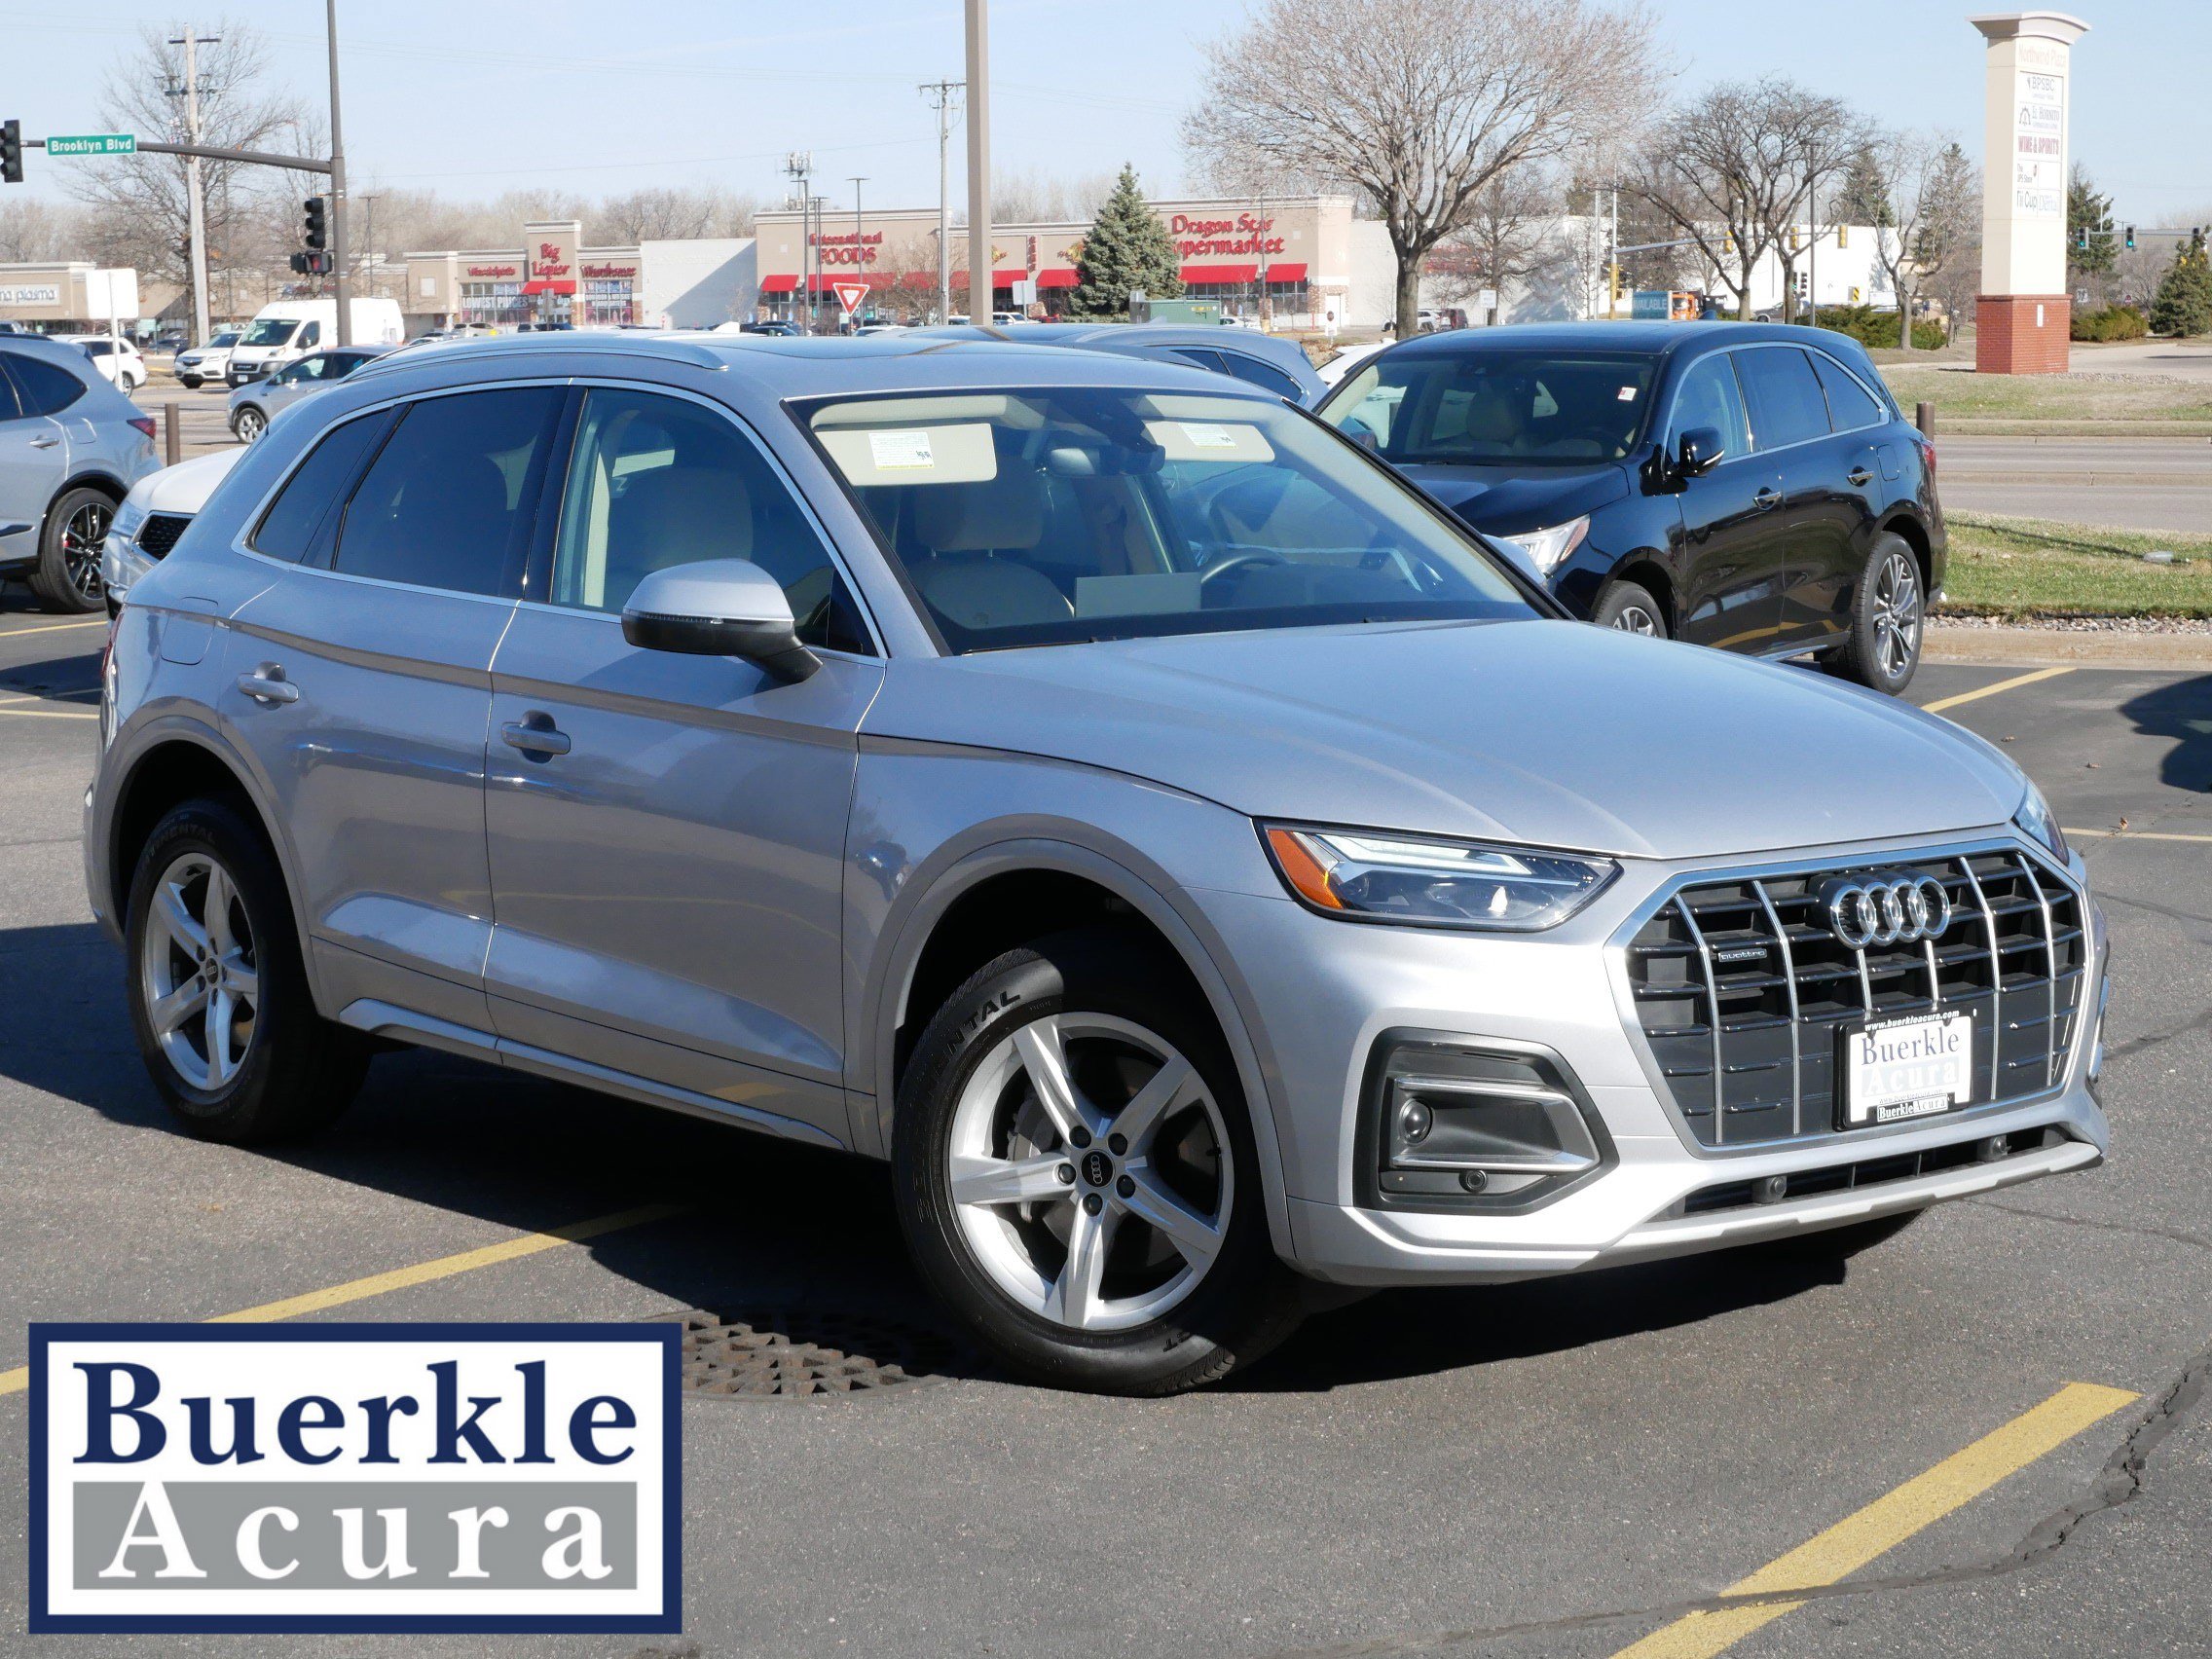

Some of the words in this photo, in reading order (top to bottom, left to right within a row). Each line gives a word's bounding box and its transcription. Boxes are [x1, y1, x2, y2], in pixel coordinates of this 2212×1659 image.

[52, 139, 102, 154] Brooklyn
[106, 138, 132, 151] Blvd
[2018, 135, 2032, 153] WINE
[2024, 190, 2038, 211] Cup
[1171, 214, 1235, 239] Dragon
[1235, 212, 1274, 233] Star
[809, 231, 882, 246] Iternational
[1173, 231, 1285, 261] upermarket
[540, 242, 561, 264] Big
[819, 246, 877, 265] FOODS
[532, 260, 571, 279] Liquor
[461, 296, 495, 309] LOWEST
[1720, 950, 1765, 960] quattro
[1863, 1009, 1960, 1032] www.buerkleacura.com
[1861, 1026, 1960, 1066] Buerkle
[1865, 1059, 1957, 1096] Acura
